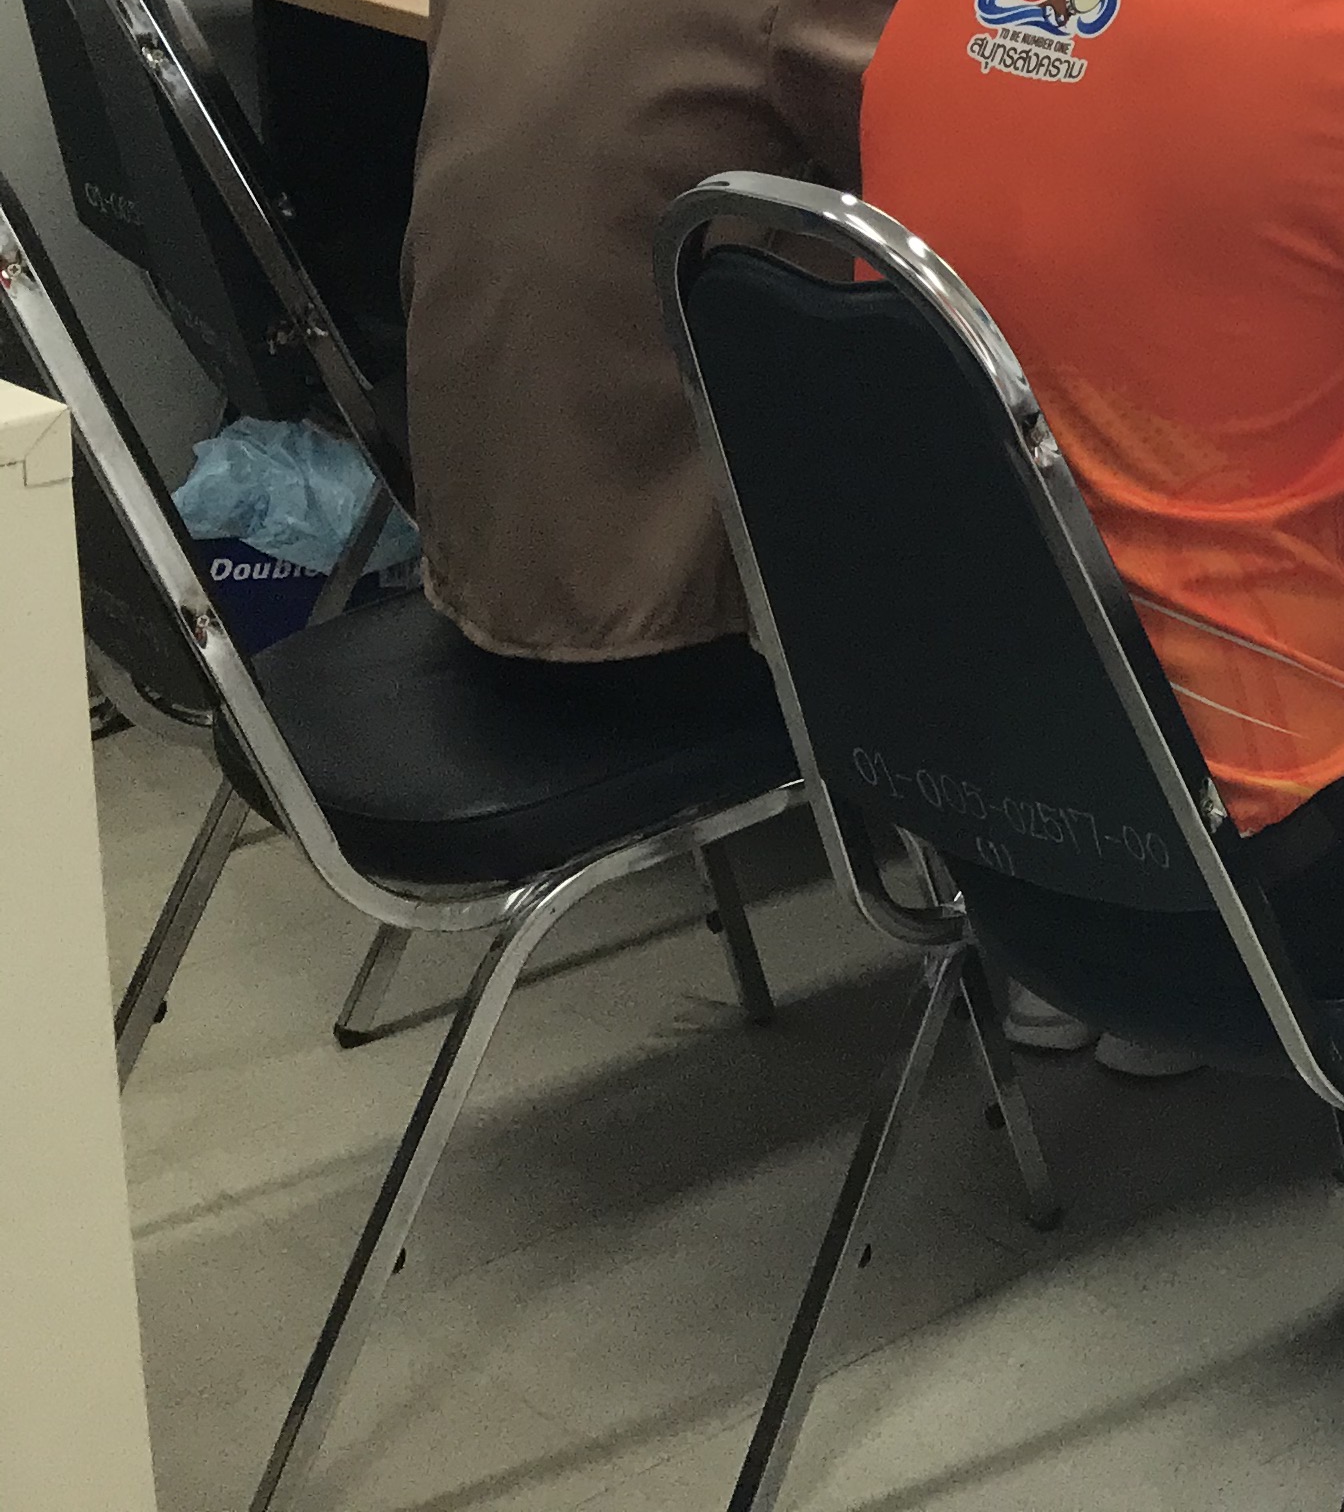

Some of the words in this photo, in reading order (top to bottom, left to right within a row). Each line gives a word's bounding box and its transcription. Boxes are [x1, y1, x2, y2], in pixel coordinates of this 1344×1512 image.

[1000, 27, 1010, 40] TO
[969, 36, 1085, 79] สมุทรสงคราม
[852, 745, 1170, 870] 01-005-02517-00
